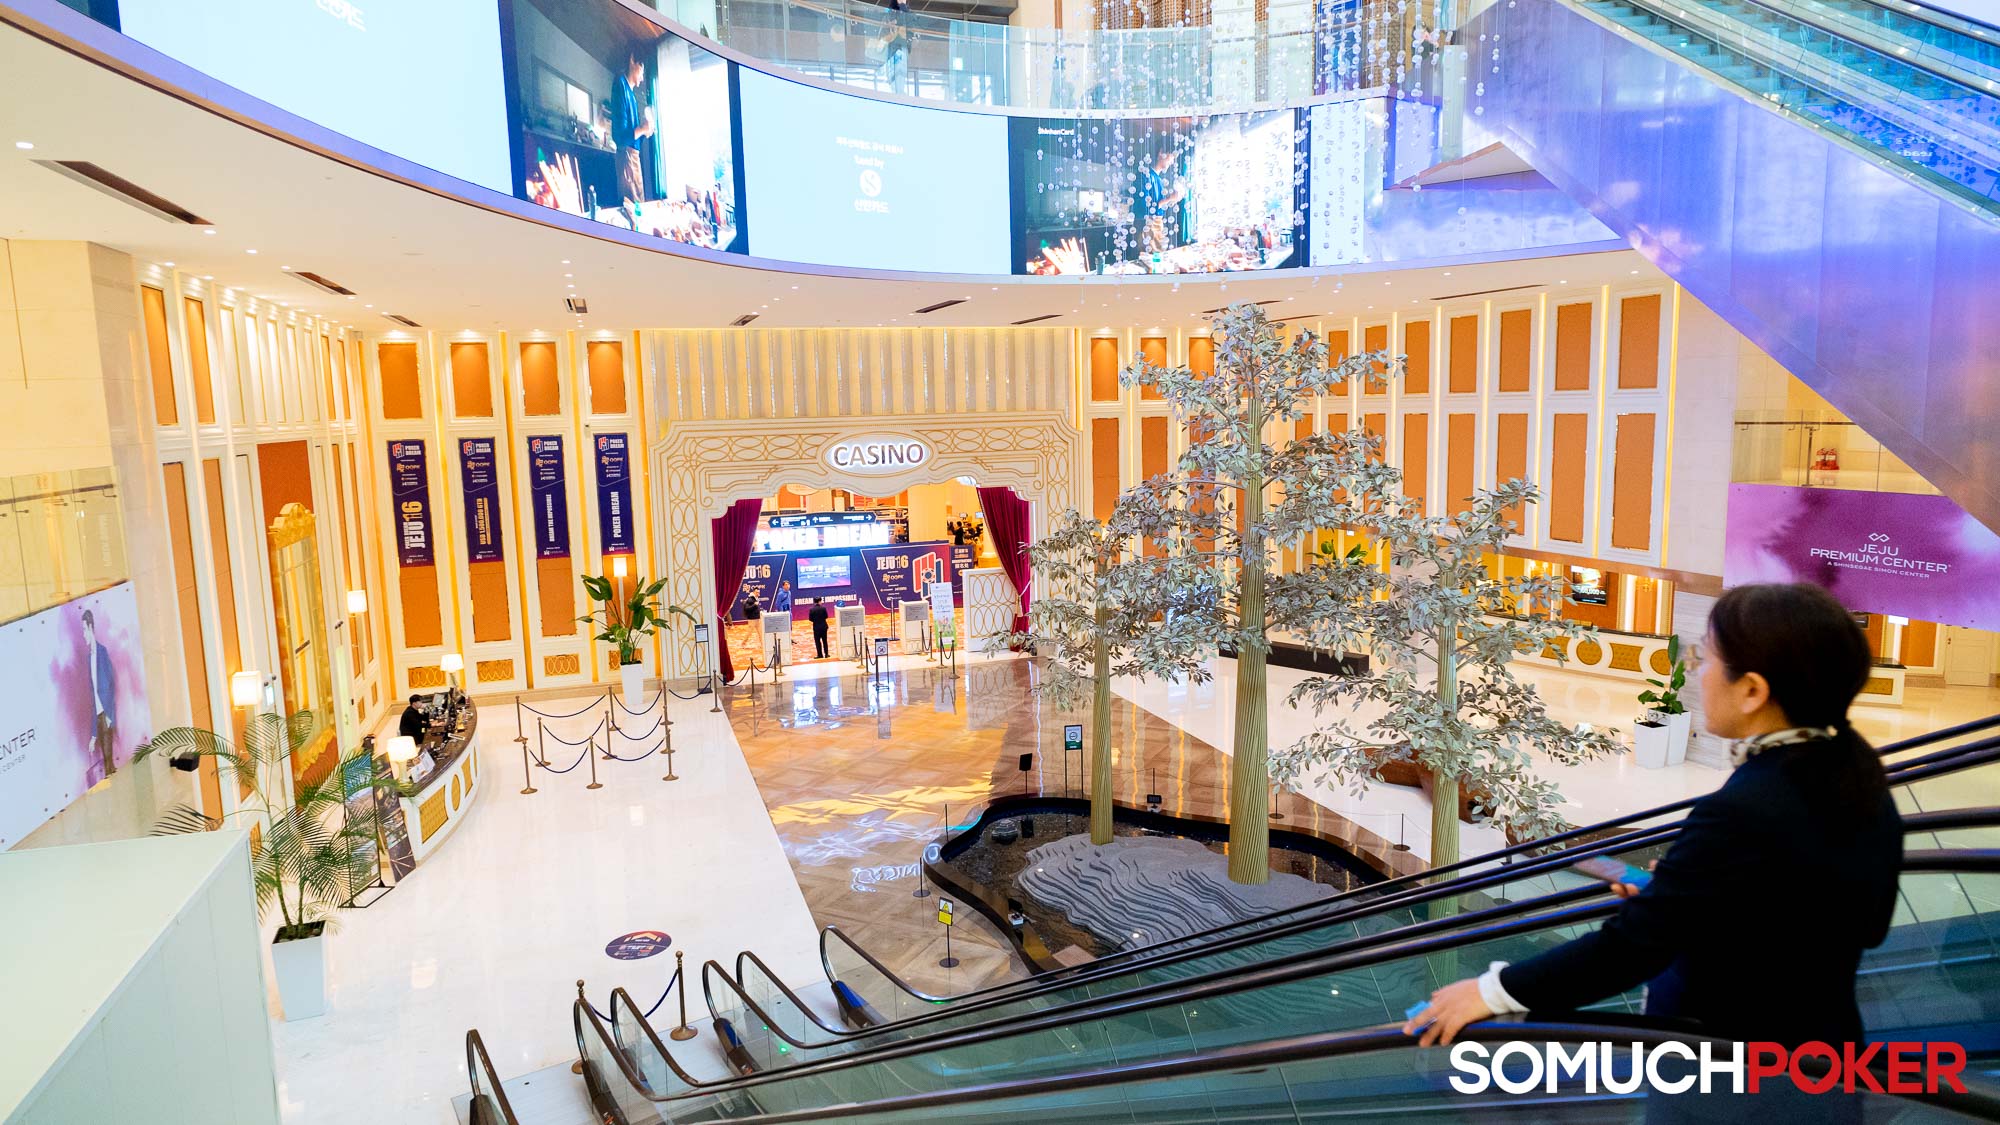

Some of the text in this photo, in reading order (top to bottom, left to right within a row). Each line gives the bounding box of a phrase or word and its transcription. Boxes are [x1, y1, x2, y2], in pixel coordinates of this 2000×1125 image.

[1037, 127, 1075, 136] ShinhanCard
[832, 442, 925, 467] CASINO
[610, 491, 620, 515] DREAM
[612, 516, 622, 538] POKER
[1858, 543, 1899, 556] JEJU
[1810, 547, 1948, 573] PREMIUM CENTER
[1874, 566, 1898, 574] SIMON
[1899, 570, 1930, 578] CENTER
[794, 597, 814, 605] DREAM
[825, 593, 857, 603] IMPOSSIBLE
